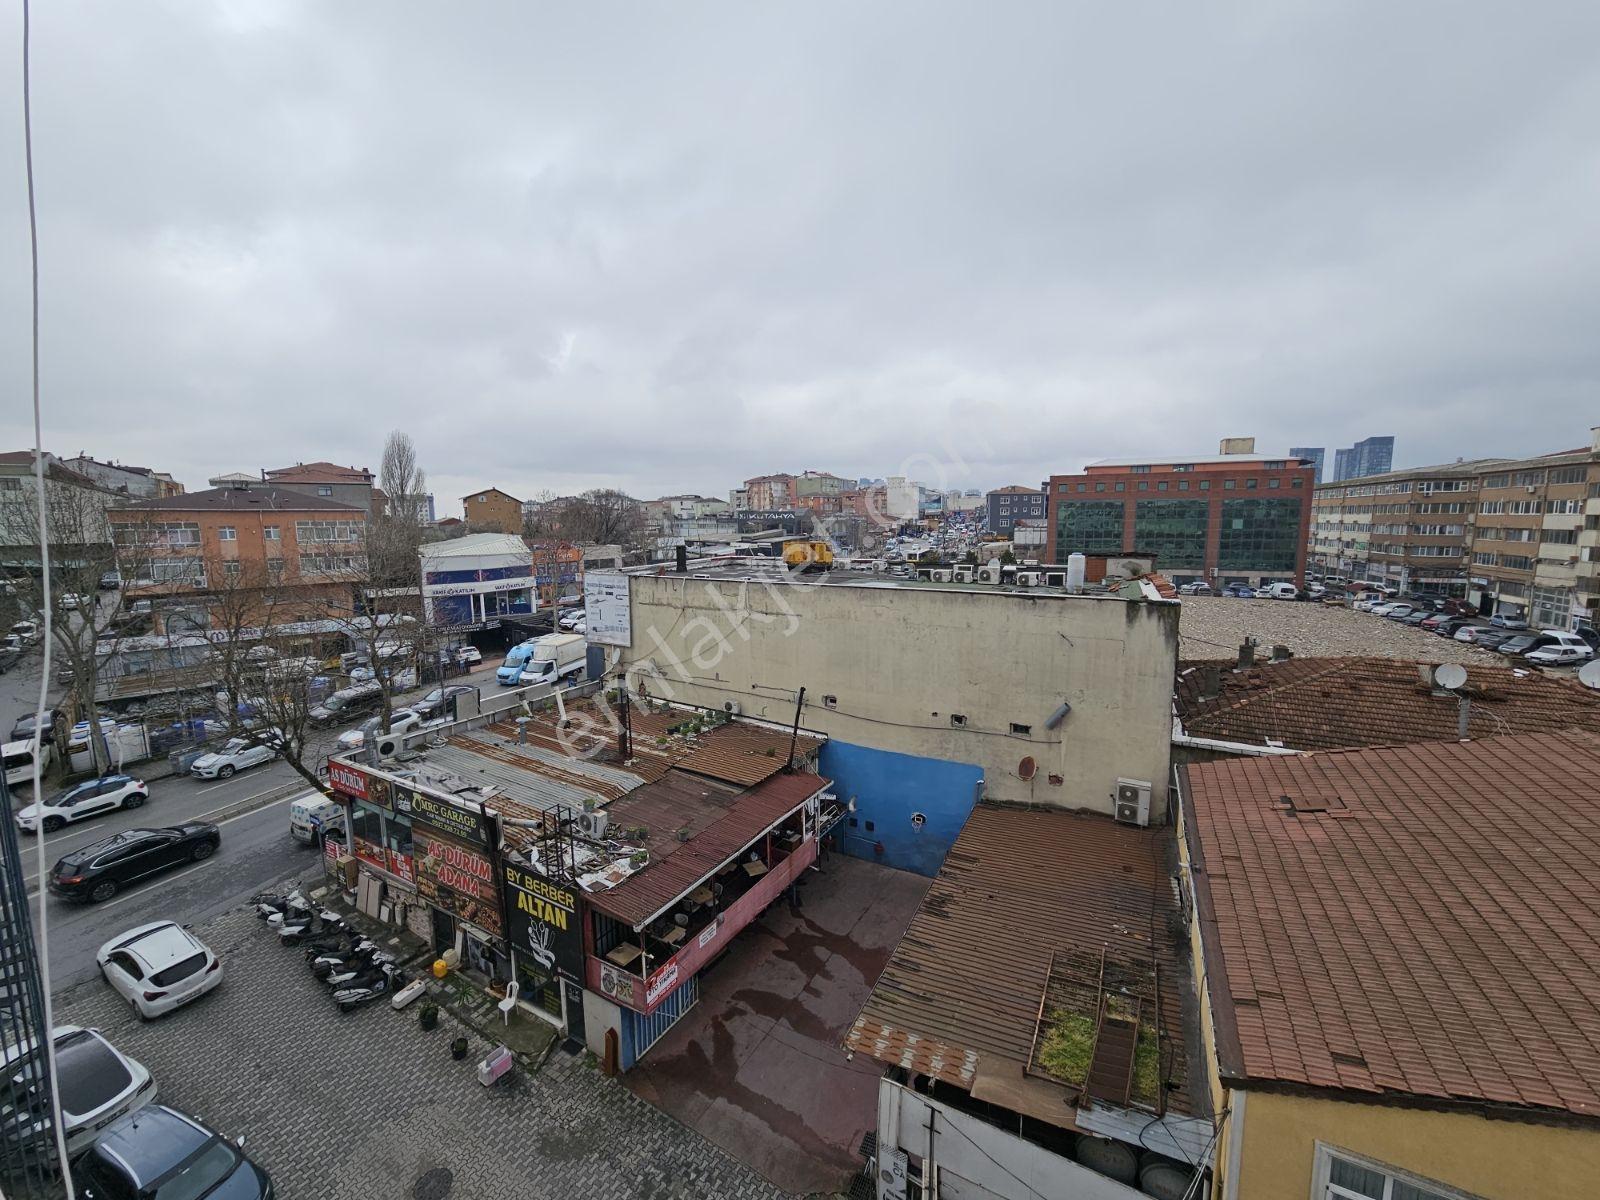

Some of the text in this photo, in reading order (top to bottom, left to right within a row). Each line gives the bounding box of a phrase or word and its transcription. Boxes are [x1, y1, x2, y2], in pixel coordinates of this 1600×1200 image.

[331, 768, 339, 783] AS
[340, 769, 365, 791] DÜRÜM
[440, 807, 477, 828] GARAGE
[428, 840, 443, 860] AS
[445, 845, 492, 882] DÜRÜM
[438, 863, 480, 899] ADANA
[506, 867, 575, 909] BY BERBER
[517, 890, 567, 931] ALTAN
